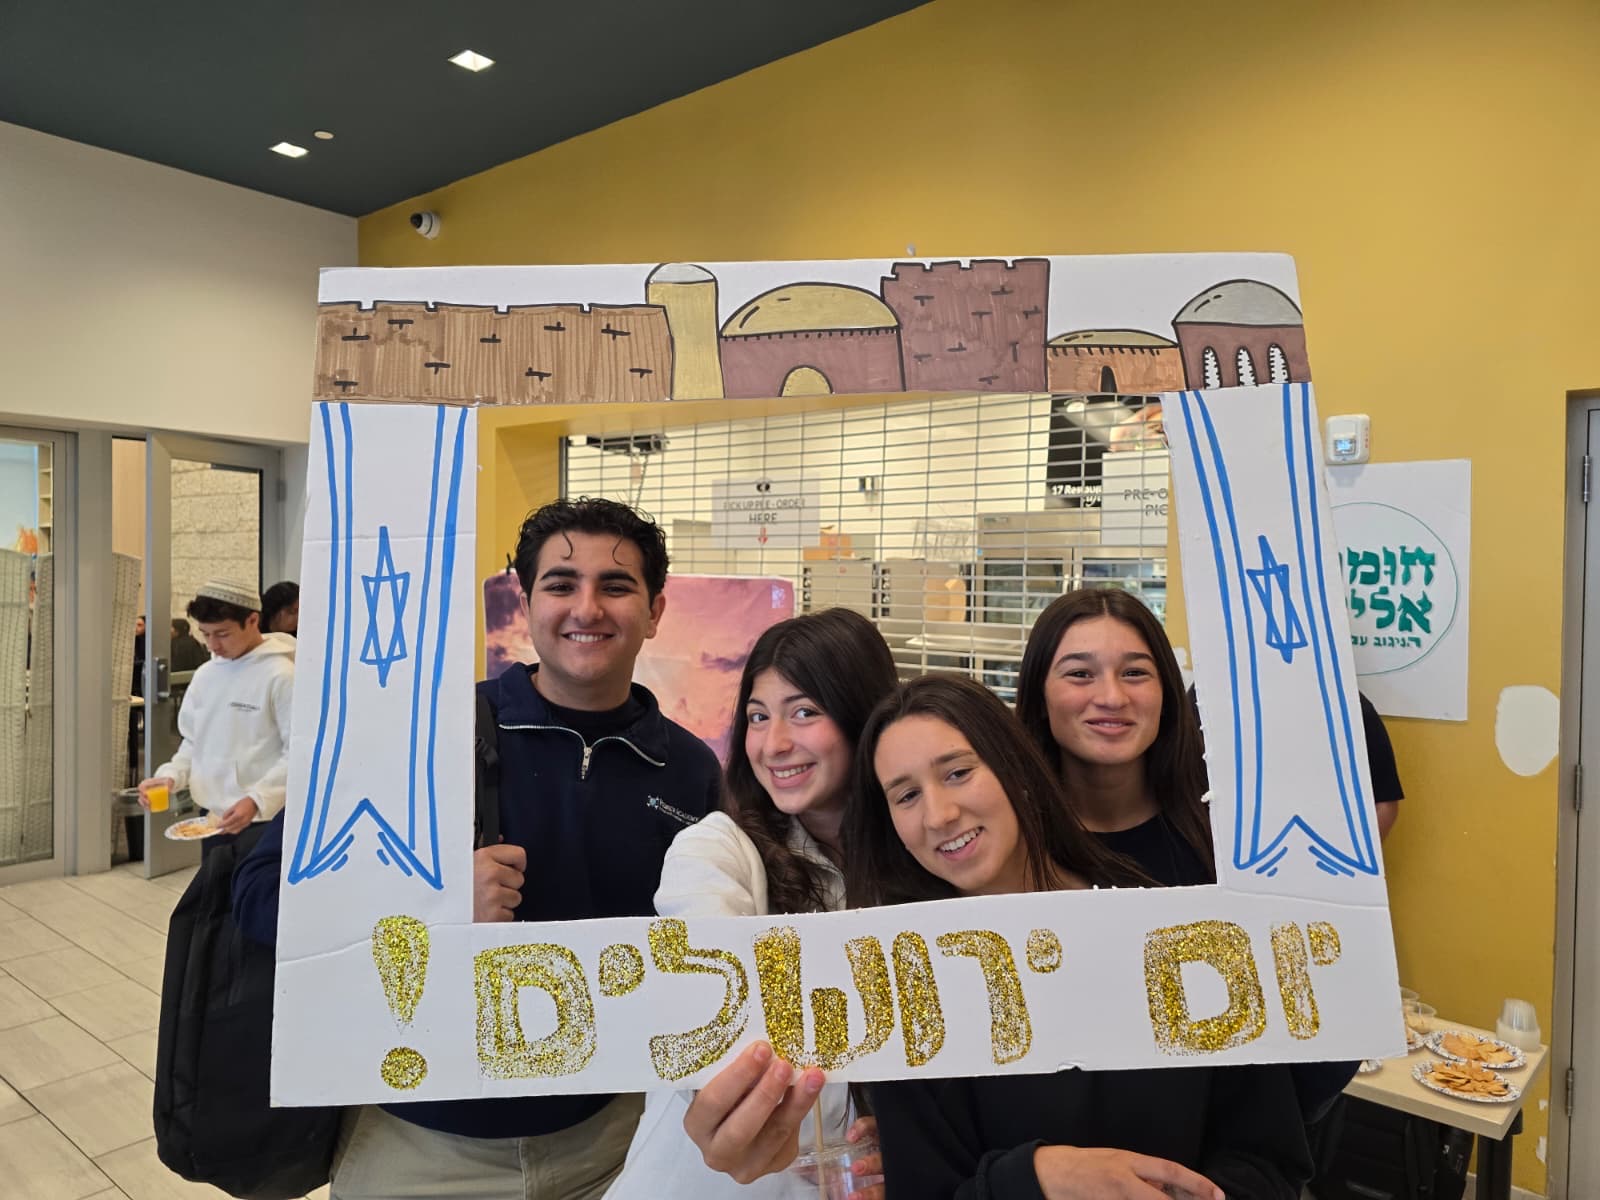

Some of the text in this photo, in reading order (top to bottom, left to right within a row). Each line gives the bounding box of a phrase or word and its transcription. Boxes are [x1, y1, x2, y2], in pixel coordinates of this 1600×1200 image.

[749, 512, 778, 524] HERE
[1339, 546, 1435, 586] חומ
[1344, 586, 1432, 634] אלי
[1143, 919, 1341, 1056] יום
